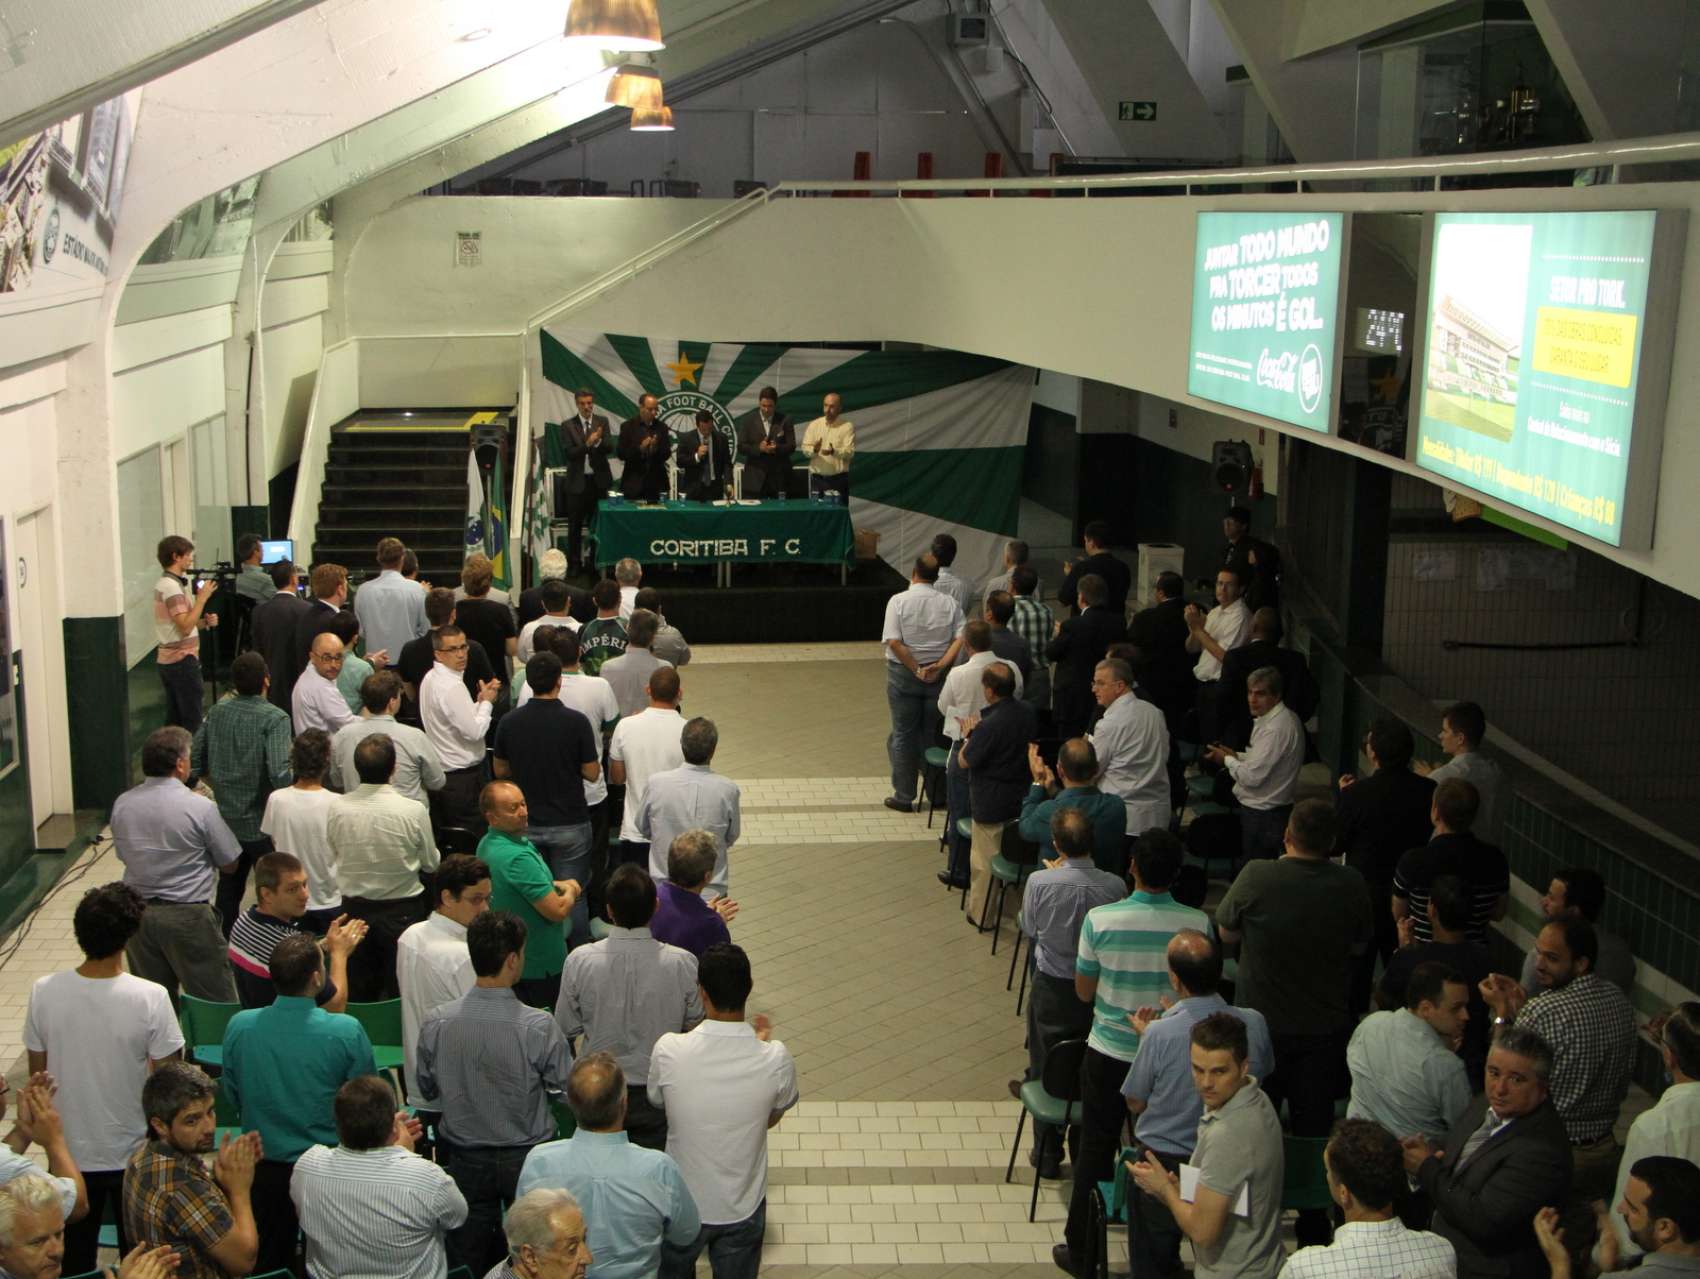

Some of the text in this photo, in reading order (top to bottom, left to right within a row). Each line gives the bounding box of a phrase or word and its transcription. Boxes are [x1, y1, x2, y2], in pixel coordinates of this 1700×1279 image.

[1240, 231, 1275, 262] TODO
[1278, 220, 1329, 257] MUNDO
[1229, 264, 1280, 299] TORCER
[1282, 262, 1318, 288] TODOS
[1212, 305, 1226, 331] OS
[1227, 301, 1275, 331] MINUTOS
[1276, 291, 1287, 332] É
[667, 396, 724, 425] FOOT BALL
[650, 539, 749, 557] CORITIBA
